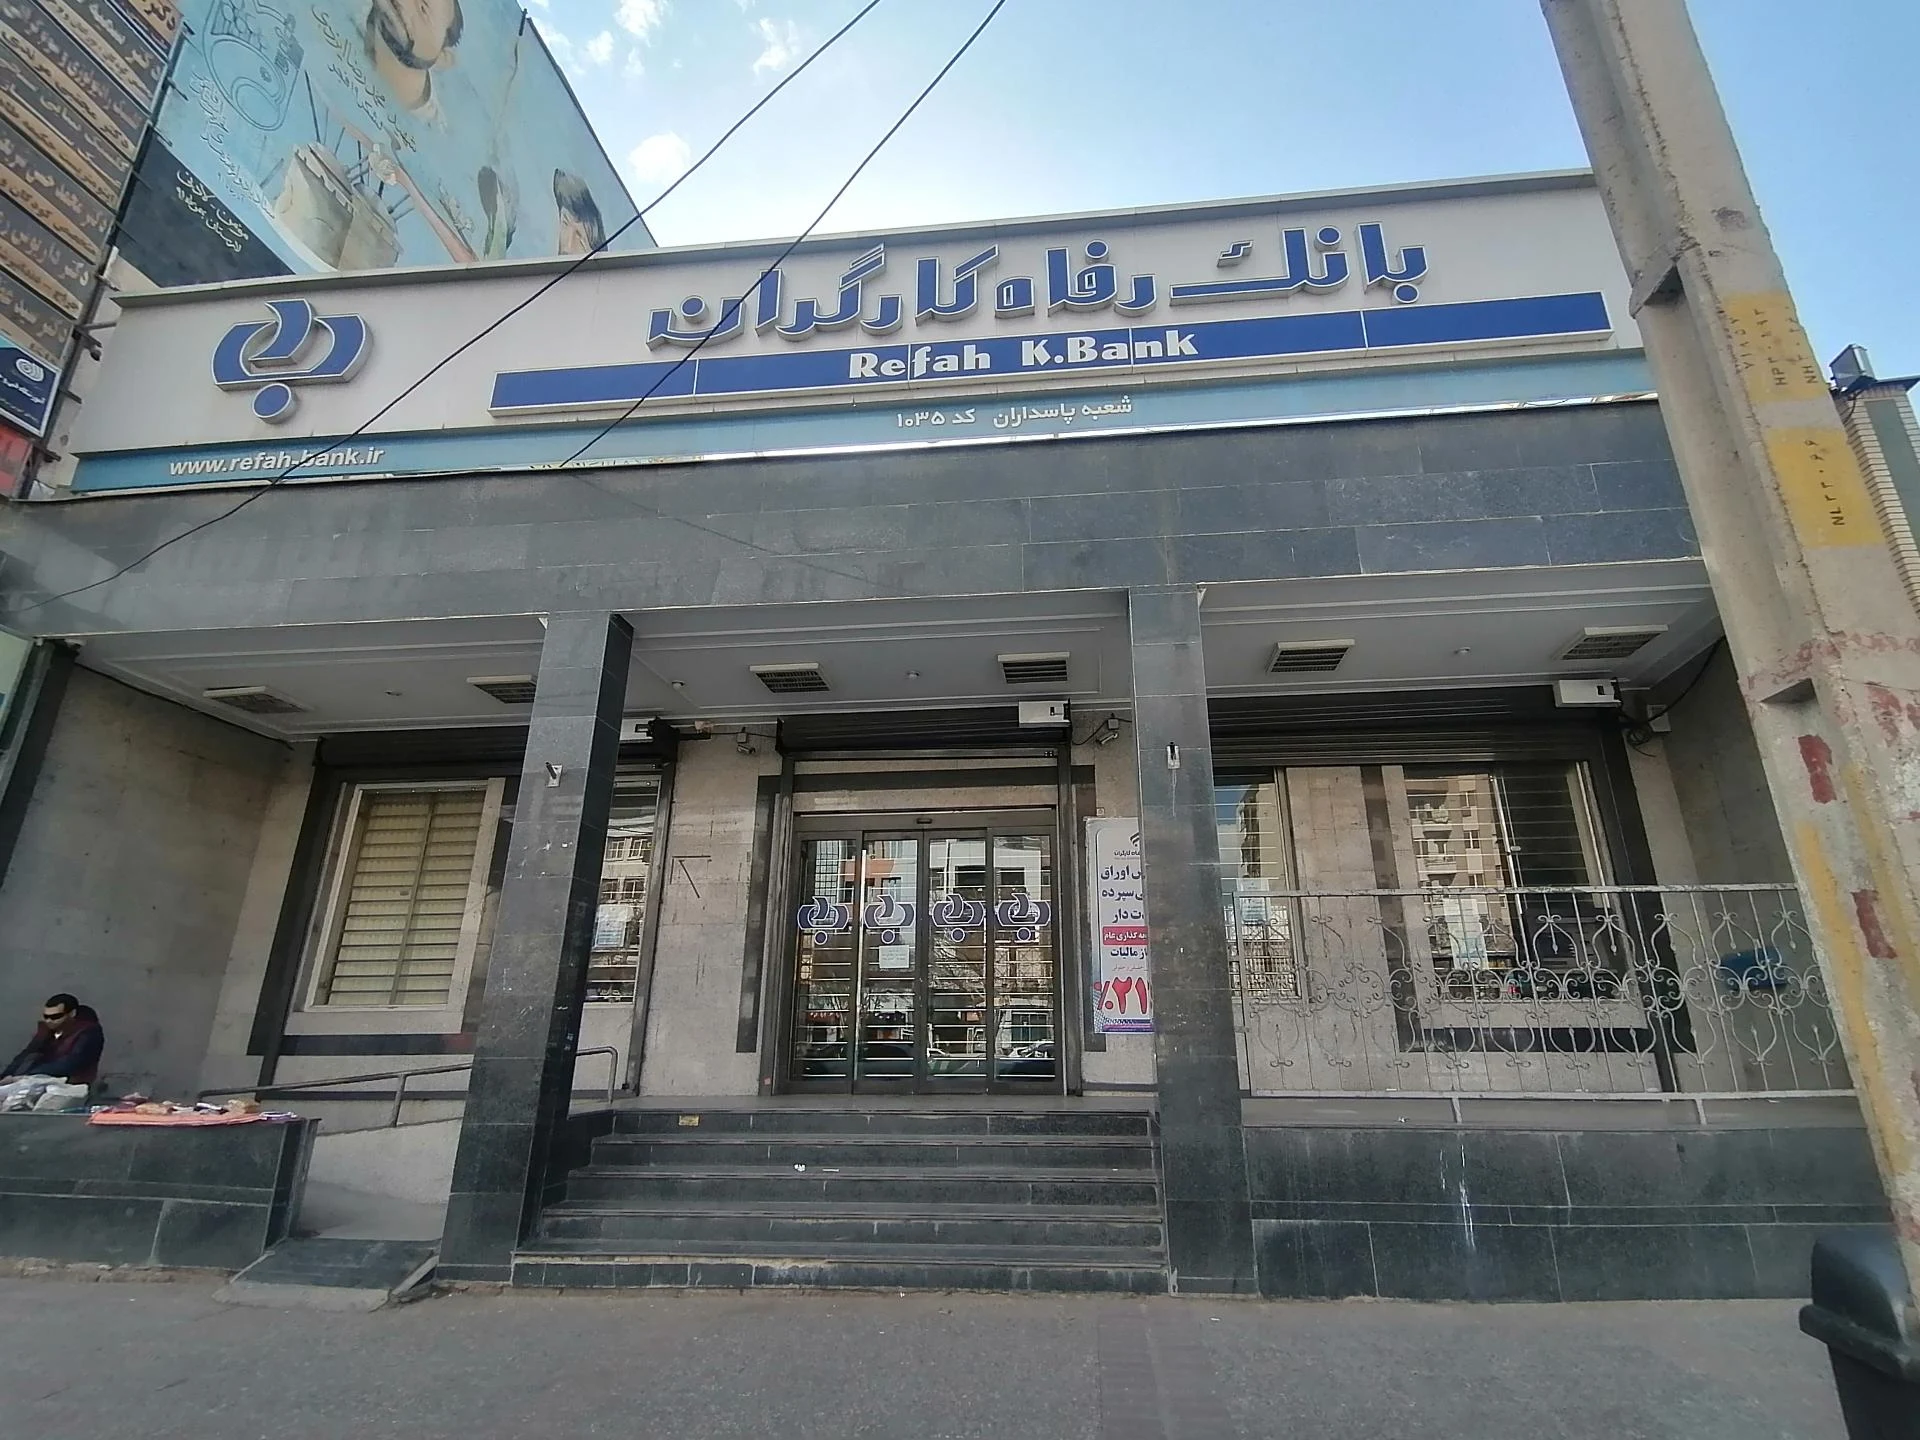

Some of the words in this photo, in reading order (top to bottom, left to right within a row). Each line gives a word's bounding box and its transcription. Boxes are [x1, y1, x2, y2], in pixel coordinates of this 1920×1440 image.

[995, 239, 1157, 320] رفاه
[646, 242, 999, 352] کارگران
[848, 343, 992, 379] Refah
[1020, 329, 1200, 368] K.Bank
[1081, 394, 1133, 415] شعبه
[896, 410, 946, 428] ۱۰۳۵
[951, 408, 976, 426] کد
[992, 401, 1077, 429] پاسداران
[168, 447, 387, 477] www.refah-bank.ir
[1100, 865, 1130, 881] اوراق
[1102, 888, 1134, 902] سپرده
[1112, 908, 1129, 923] دار
[1110, 946, 1139, 960] مالیات
